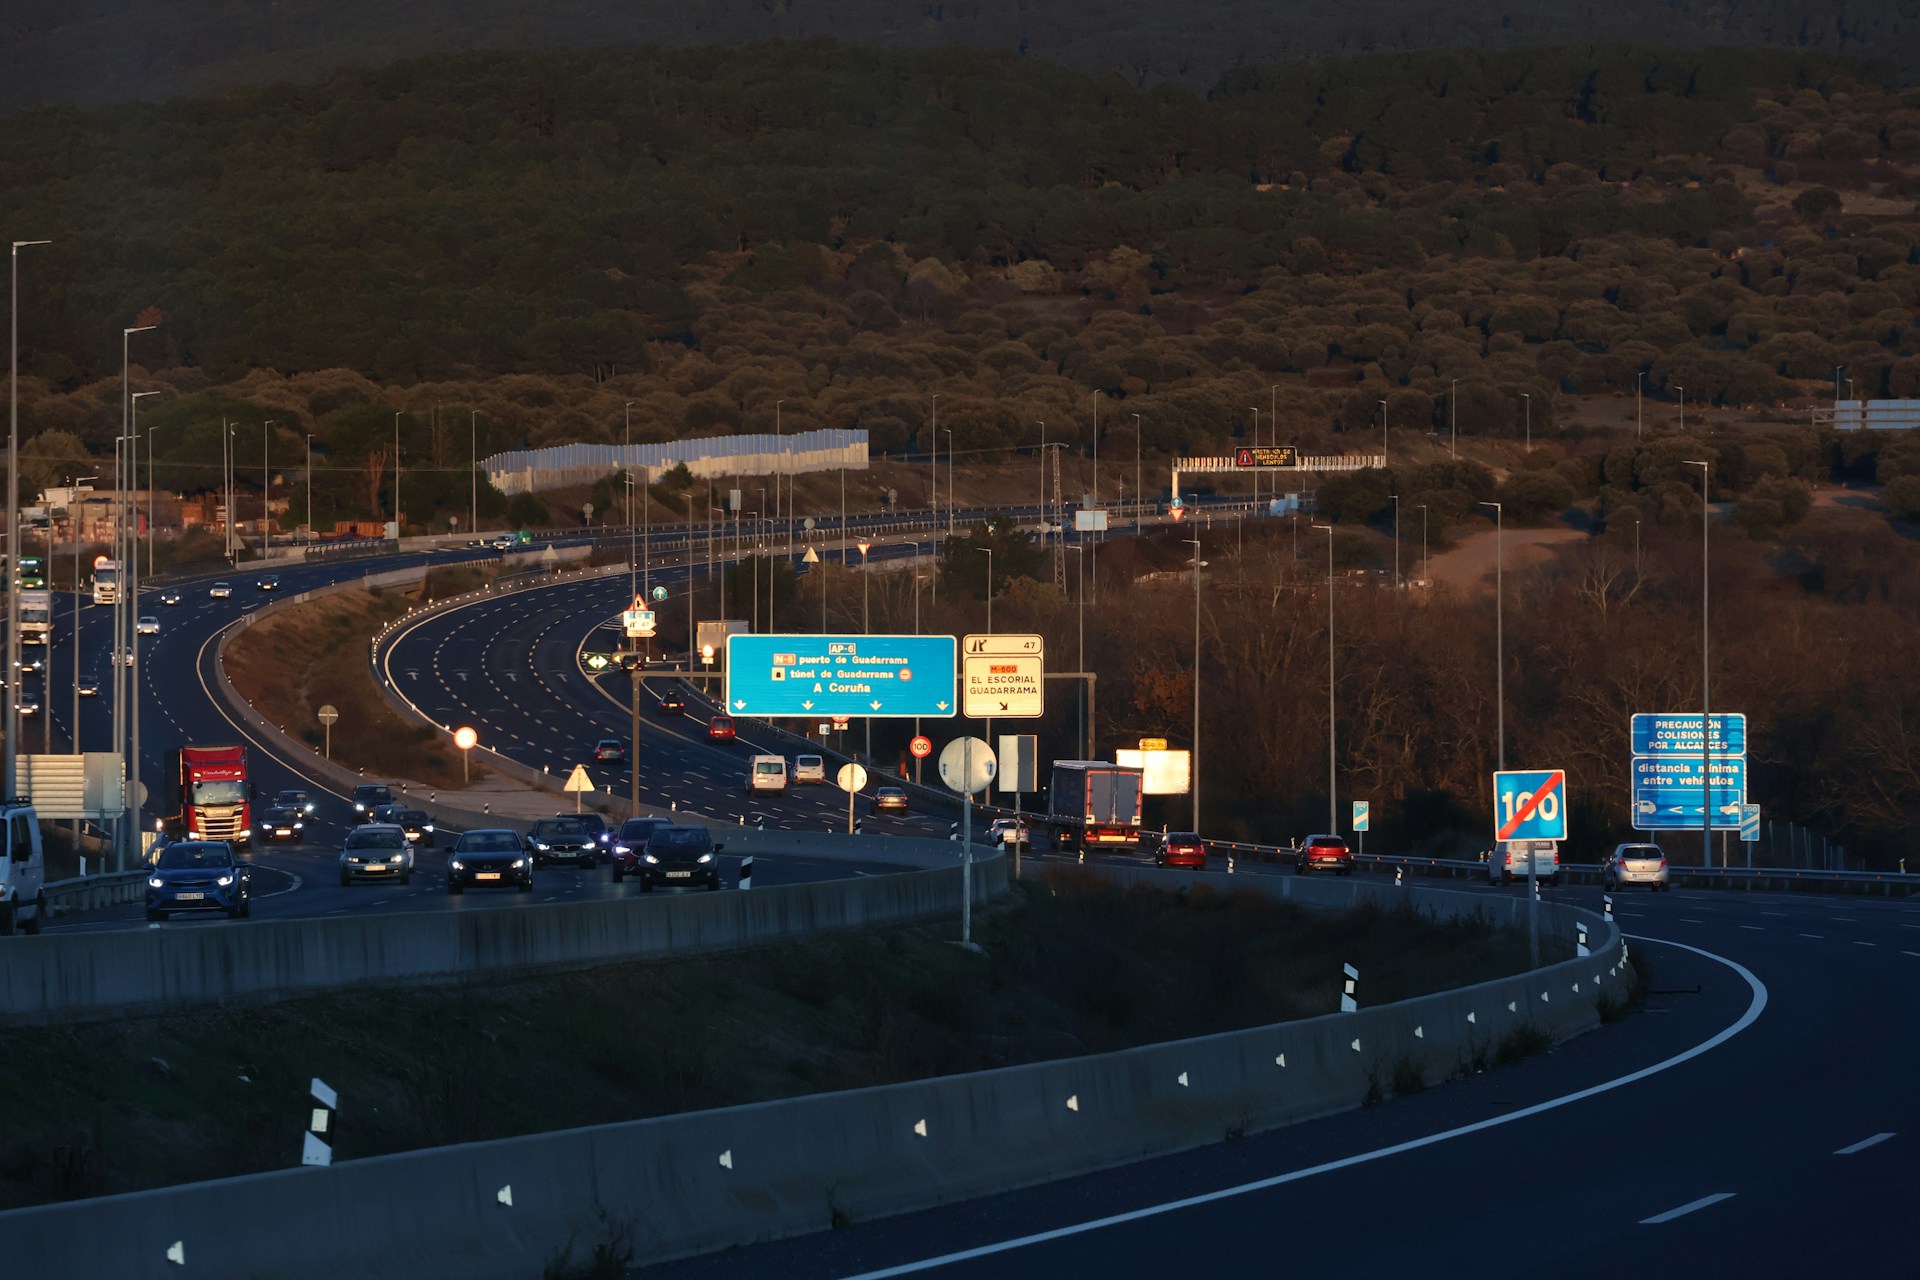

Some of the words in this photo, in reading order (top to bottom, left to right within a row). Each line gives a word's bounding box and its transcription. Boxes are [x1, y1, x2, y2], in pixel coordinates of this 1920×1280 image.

[831, 645, 854, 653] AP-6
[1023, 641, 1036, 649] 47
[776, 655, 793, 664] N-6
[799, 656, 830, 665] puerto
[835, 655, 847, 664] de
[852, 655, 908, 664] Guadarrama
[790, 670, 815, 678] túnel
[820, 670, 832, 678] de
[837, 670, 894, 678] Guadarrama
[971, 676, 982, 684] EL
[813, 683, 822, 693] A
[829, 682, 871, 693] Coruña
[1655, 719, 1721, 729] PRECAUCÓN
[1638, 764, 1690, 773] distancia
[1643, 776, 1673, 785] entre
[1679, 776, 1734, 785] vehíulos
[1502, 791, 1559, 821] 100
